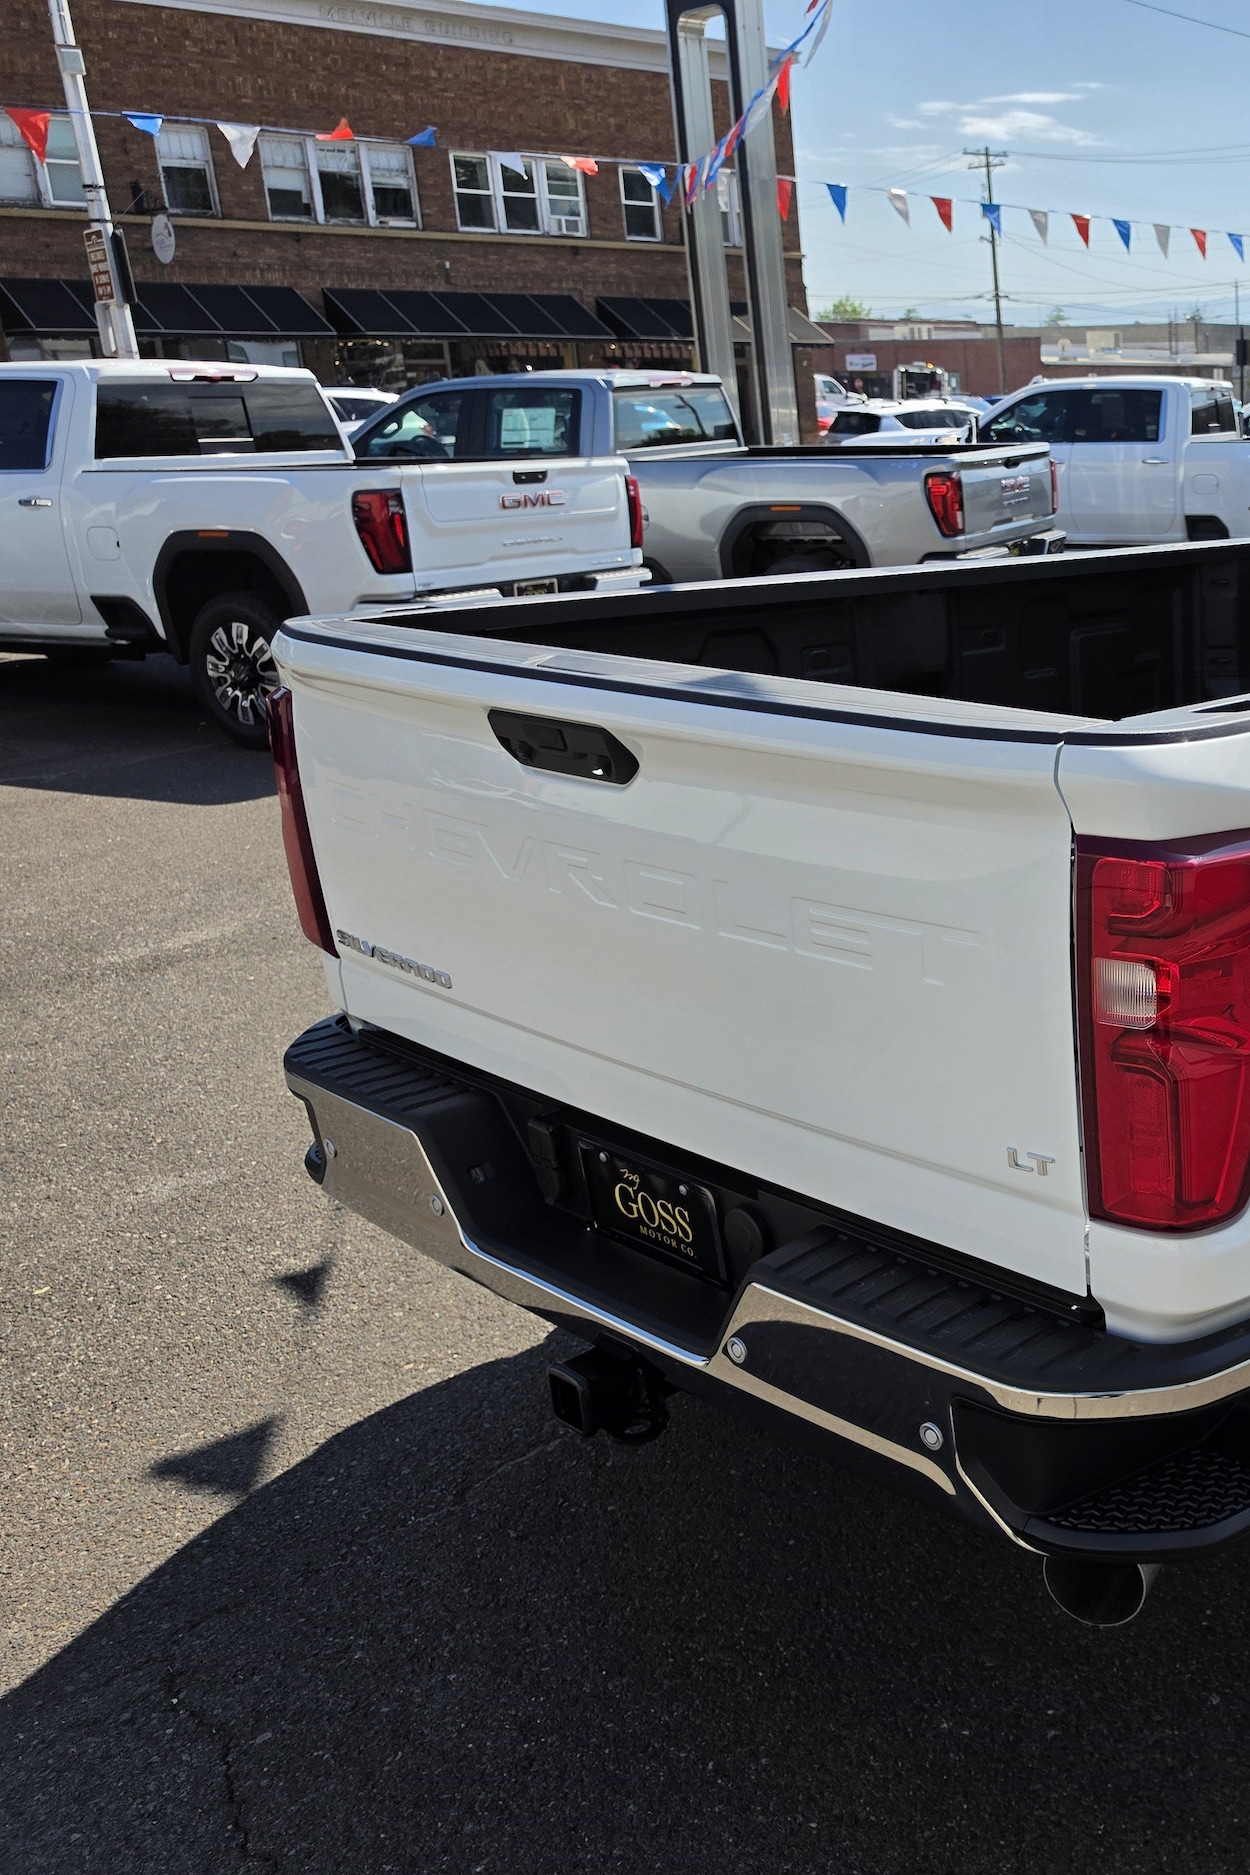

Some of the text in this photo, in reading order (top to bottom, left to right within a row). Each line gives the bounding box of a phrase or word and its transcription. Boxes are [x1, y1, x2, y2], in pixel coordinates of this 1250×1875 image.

[318, 5, 514, 44] MELVILLE BUILDING
[500, 490, 565, 510] GMC
[326, 777, 980, 986] CHEVROLET
[336, 929, 452, 989] SILVERADO
[1007, 1146, 1055, 1176] LT
[614, 1183, 693, 1242] GOSS
[639, 1224, 698, 1259] MOTOR CO.
